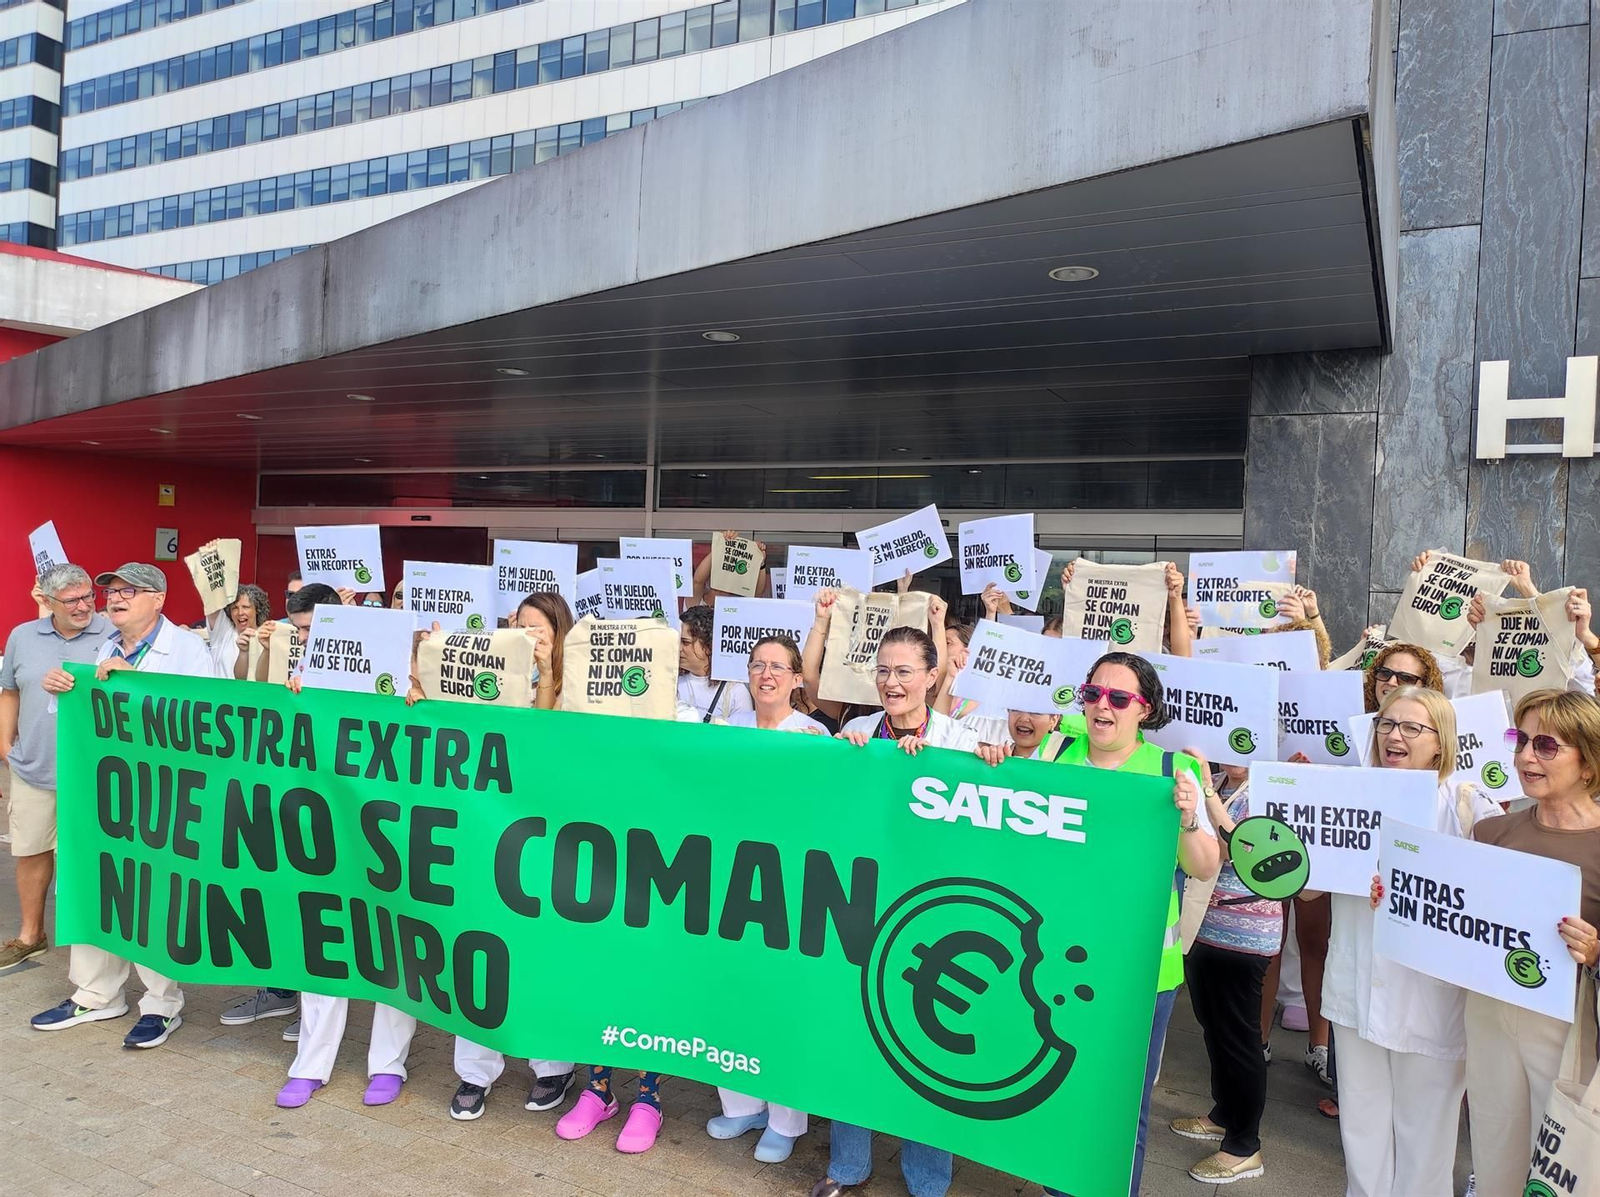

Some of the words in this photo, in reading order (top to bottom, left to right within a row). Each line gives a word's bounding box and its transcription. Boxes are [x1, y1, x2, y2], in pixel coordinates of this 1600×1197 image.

[1476, 356, 1598, 459] H
[167, 537, 177, 553] 6
[882, 542, 892, 552] MI
[884, 551, 894, 561] MI
[897, 536, 932, 558] DERECHO
[964, 543, 990, 557] EXTRAS
[305, 548, 336, 560] EXTRAS
[732, 549, 753, 560] COMAN
[964, 558, 974, 570] SIN
[976, 554, 1014, 570] RECORTES
[307, 560, 320, 571] SIN
[322, 559, 364, 571] RECORTES
[499, 566, 506, 578] ES
[508, 567, 518, 579] MI
[794, 565, 805, 574] MI
[806, 566, 835, 577] EXTRA
[1434, 562, 1457, 576] QUE
[1454, 570, 1472, 580] NO
[498, 579, 506, 590] ES
[507, 580, 516, 592] MI
[518, 581, 560, 593] DERECHO
[605, 584, 612, 596] ES
[614, 585, 622, 596] MI
[794, 576, 805, 585] NO
[808, 576, 818, 586] SE
[820, 577, 842, 588] TOCA
[1196, 578, 1238, 590] EXTRAS
[1425, 574, 1440, 584] SE
[1439, 578, 1478, 598] COMAN
[411, 587, 423, 599] DE
[425, 588, 436, 600] MI
[438, 589, 474, 603] EXTRA,
[1086, 586, 1108, 599] QUE
[1110, 588, 1126, 600] NO
[1196, 591, 1210, 602] SIN
[1216, 590, 1272, 602] RECORTES
[1417, 584, 1432, 596] NI
[1430, 588, 1448, 602] UN
[411, 599, 420, 612] NI
[422, 600, 436, 613] UN
[438, 602, 463, 614] EURO
[575, 599, 588, 612] POR
[607, 597, 614, 609] ES
[615, 598, 623, 610] MI
[624, 599, 662, 611] DERECHO
[1085, 600, 1096, 612] SE
[1100, 602, 1140, 616] COMAN
[1412, 596, 1440, 615] EURO
[1084, 614, 1094, 626] NI
[1098, 615, 1113, 628] UN
[1501, 617, 1522, 630] QUE
[1524, 617, 1540, 630] NO
[590, 633, 614, 646] QUE
[618, 632, 636, 646] NO
[722, 625, 741, 639] POR
[1082, 628, 1111, 640] EURO
[1494, 632, 1511, 644] SE
[313, 638, 326, 652] MI
[326, 639, 362, 656] EXTRA
[445, 635, 470, 648] QUE
[472, 637, 490, 652] NO
[442, 648, 456, 662] SE
[459, 652, 505, 670] COMAN
[590, 648, 604, 662] SE
[608, 648, 652, 662] COMAN
[978, 646, 998, 660] MI
[998, 652, 1045, 673] EXTRA
[1492, 646, 1504, 660] NI
[1504, 647, 1522, 660] UN
[309, 654, 324, 669] NO
[327, 655, 340, 670] SE
[344, 657, 372, 674] TOCA
[588, 665, 602, 678] NI
[606, 665, 624, 679] UN
[973, 658, 994, 674] NO
[996, 664, 1015, 680] SE
[1018, 670, 1052, 686] TOCA
[1490, 662, 1516, 676] EURO
[440, 664, 454, 678] NI
[457, 668, 475, 682] UN
[440, 680, 474, 698] EURO
[586, 682, 622, 696] EURO
[1166, 687, 1182, 704] MI
[1186, 690, 1238, 713] EXTRA,
[1164, 704, 1182, 721] UN
[1186, 707, 1224, 728] EURO
[92, 688, 130, 743] DE
[142, 697, 316, 771] NUESTRA
[335, 717, 513, 794] EXTRA
[1268, 776, 1298, 786] SATSE
[908, 776, 1088, 844] SATSE
[1294, 804, 1316, 824] MI
[1320, 826, 1370, 850] EURO
[1394, 839, 1420, 854] SATSE
[97, 755, 206, 860] QUE
[221, 779, 337, 876] NO
[360, 800, 458, 906] SE
[494, 816, 879, 967] COMAN
[1391, 868, 1464, 910] EXTRAS
[1389, 892, 1418, 922] SIN
[1422, 903, 1531, 950] RECORTES
[99, 852, 152, 948] NI
[166, 872, 272, 969] UN
[297, 891, 511, 1030] EURO
[601, 1024, 761, 1075] #ComePagas
[1544, 1114, 1566, 1135] EXTRA
[1537, 1124, 1561, 1154] NO
[1532, 1147, 1578, 1194] MAN
